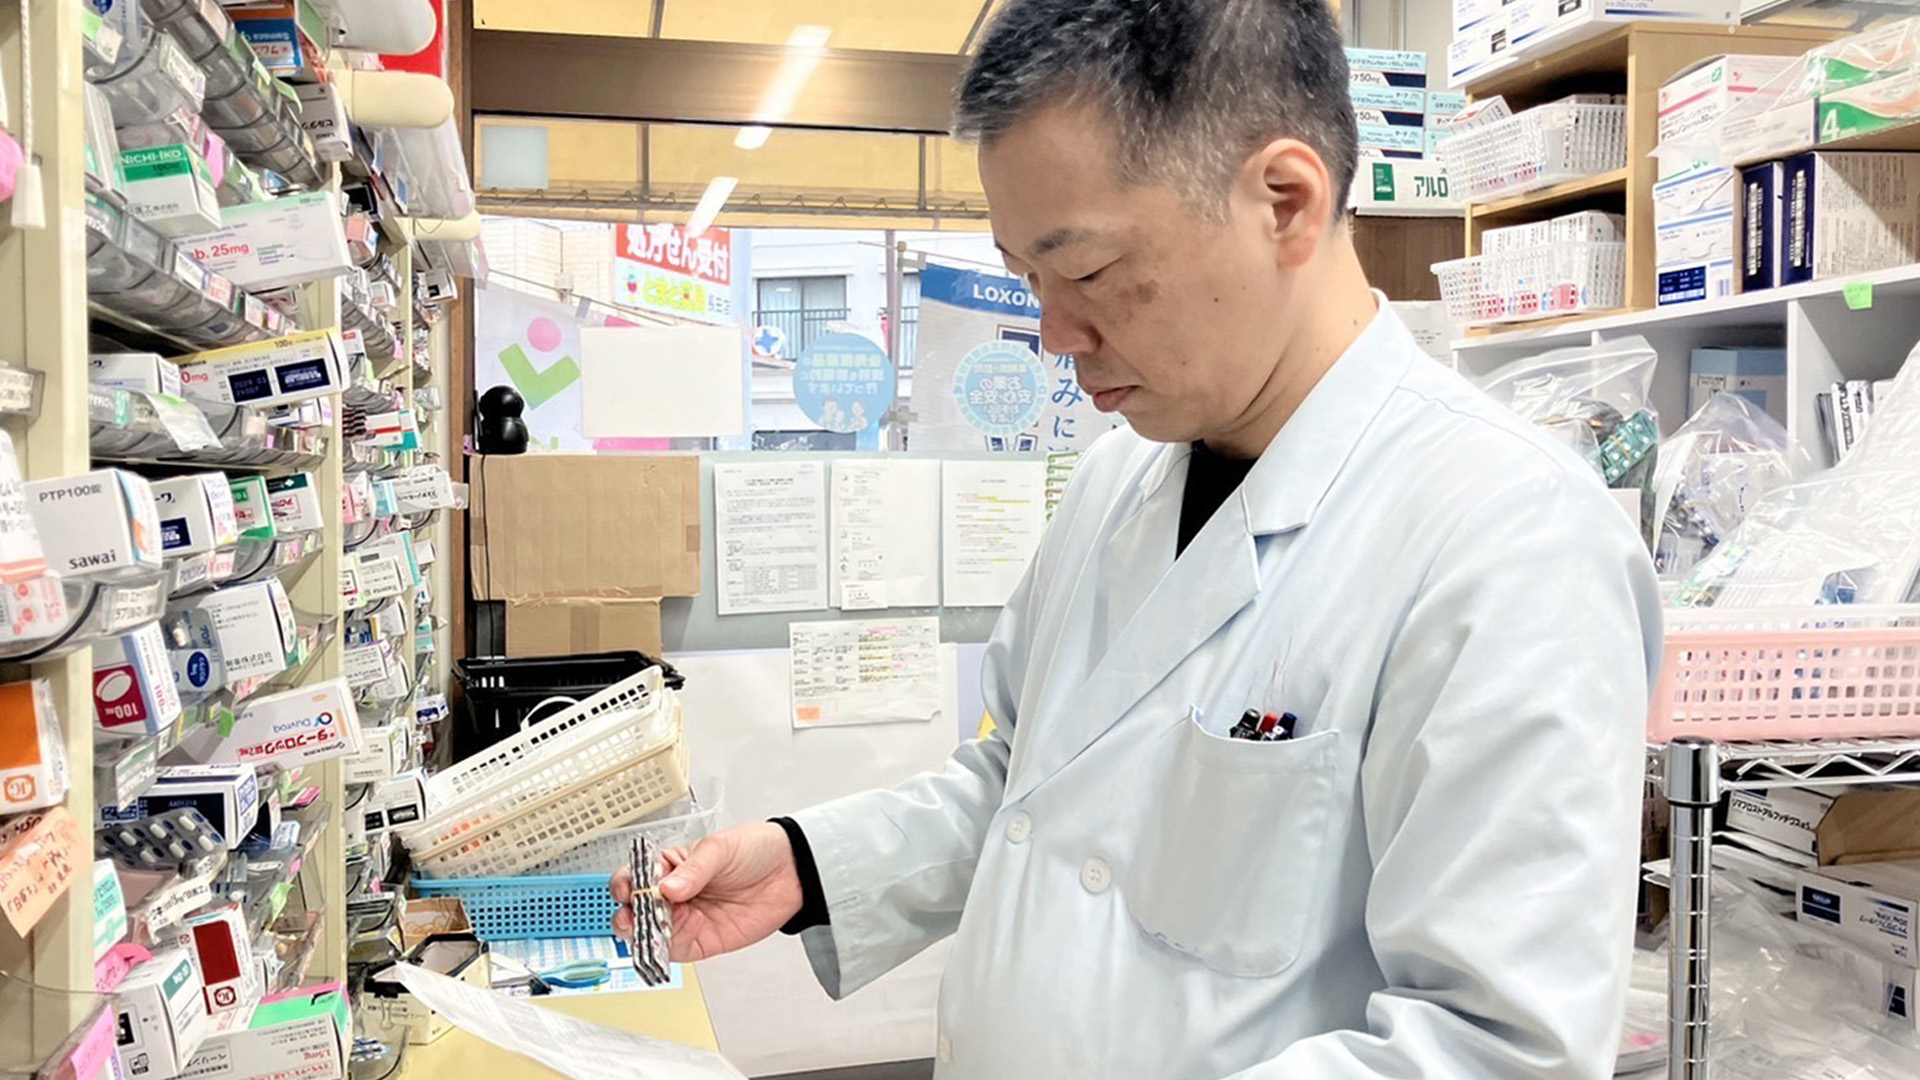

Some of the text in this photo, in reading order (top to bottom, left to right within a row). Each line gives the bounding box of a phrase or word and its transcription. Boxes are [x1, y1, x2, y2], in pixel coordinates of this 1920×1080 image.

[121, 148, 183, 166] NICHI-IKO
[1413, 175, 1449, 198] アルロ
[211, 242, 250, 259] 25mg
[626, 223, 729, 281] 処方せん受付
[68, 549, 118, 570] sawai
[273, 716, 312, 734] Duvroq
